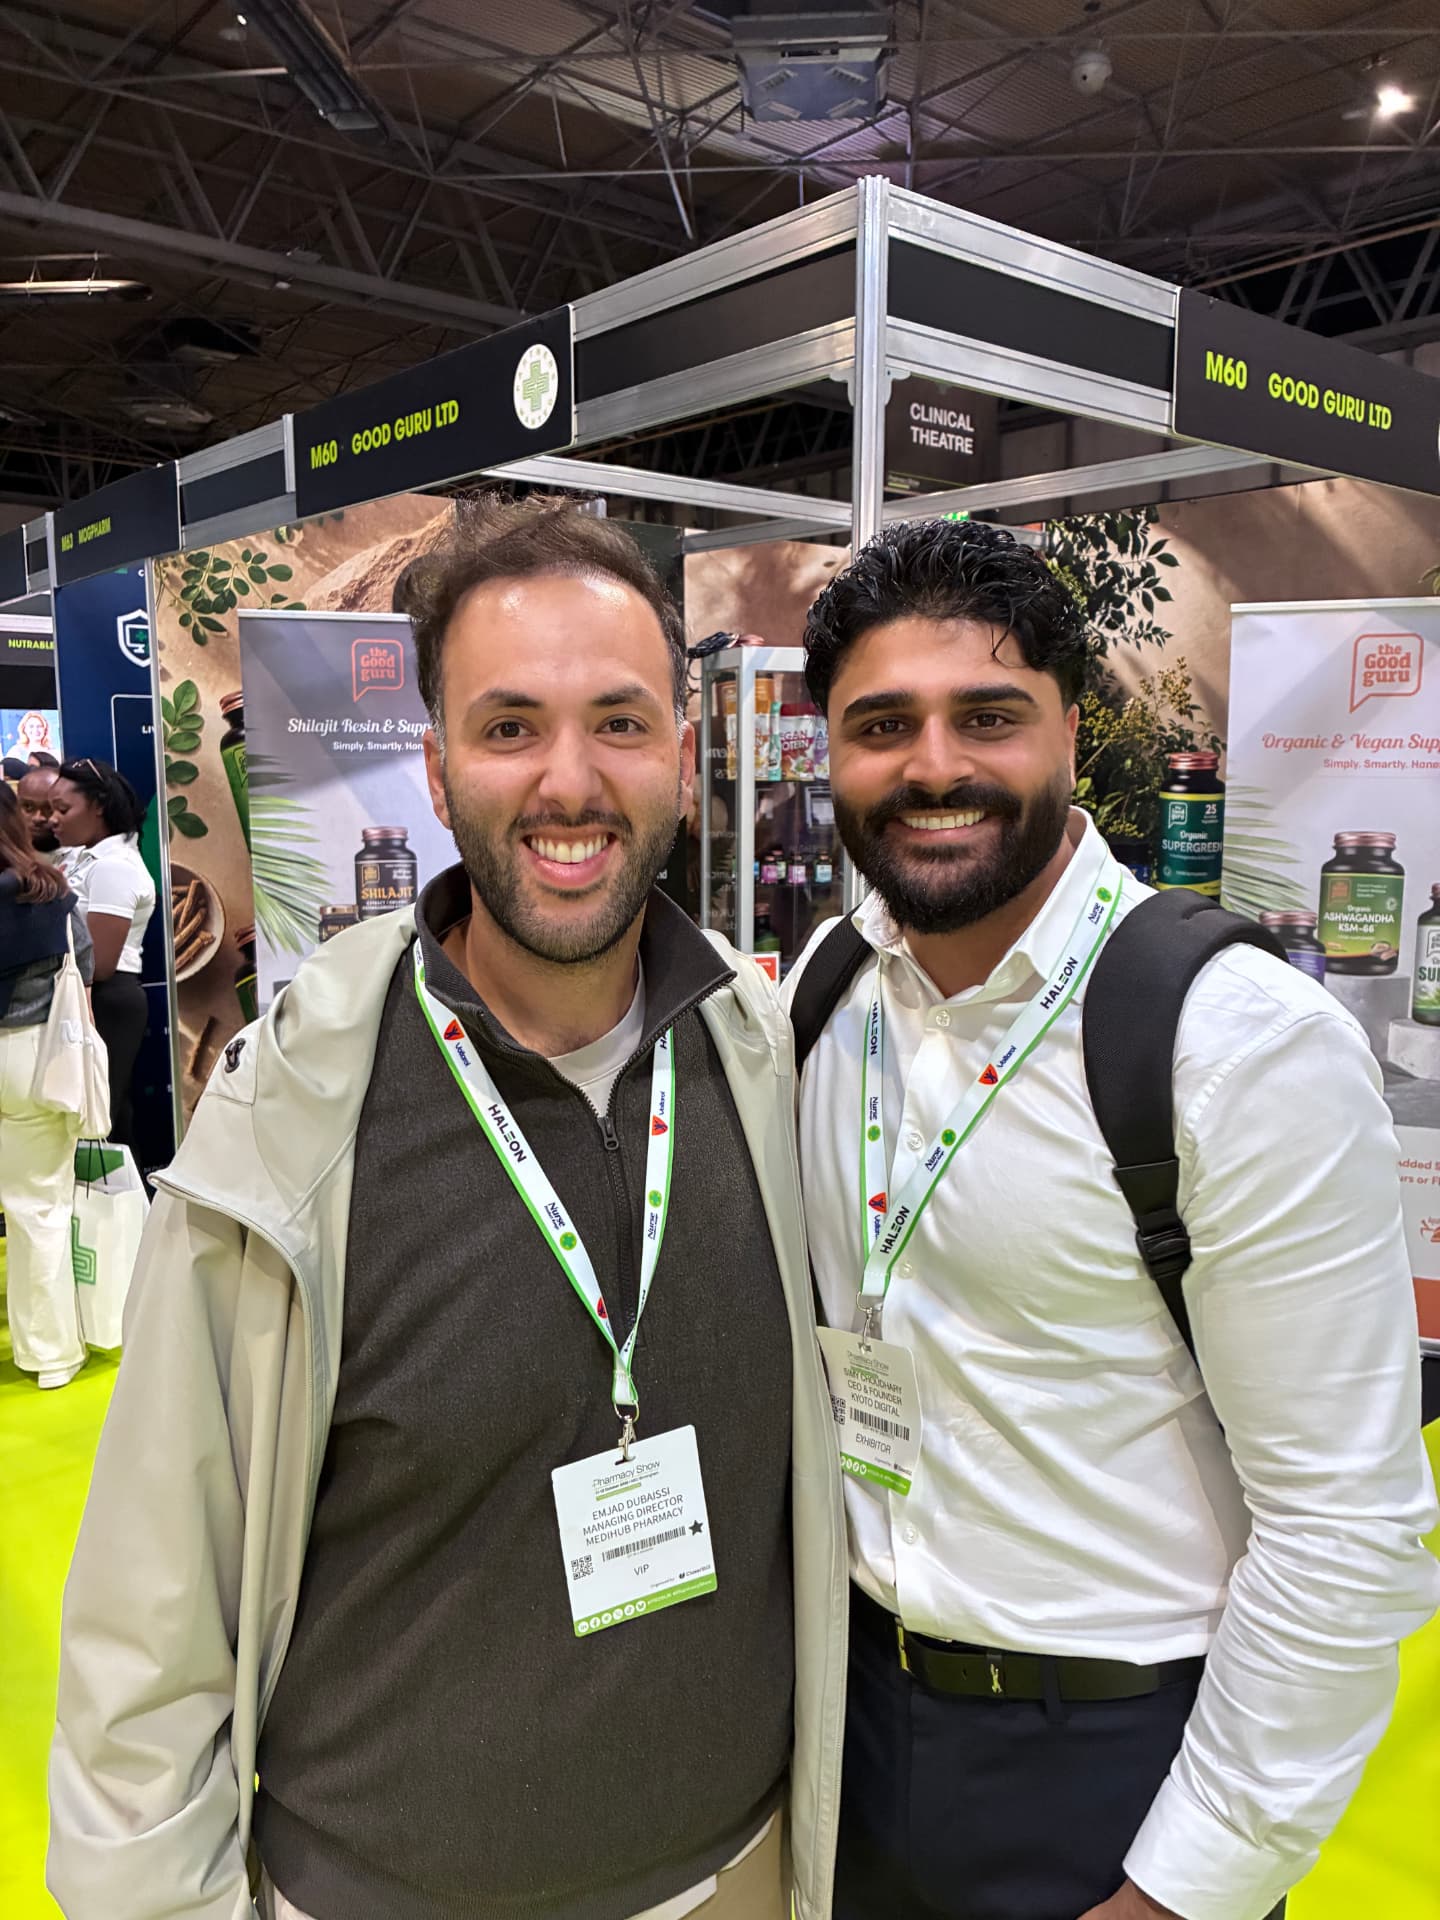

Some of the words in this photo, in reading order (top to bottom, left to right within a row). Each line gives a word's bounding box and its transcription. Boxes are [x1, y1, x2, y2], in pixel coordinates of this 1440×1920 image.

[1205, 351, 1247, 390] M60
[1268, 372, 1320, 410] GOOD
[1323, 389, 1365, 423] GURU
[1368, 402, 1393, 430] LTD
[910, 403, 975, 432] CLINICAL
[310, 439, 338, 469] M60
[351, 423, 391, 455] GOOD
[394, 408, 432, 441] GURU
[435, 400, 460, 428] LTD
[910, 426, 974, 454] THEATRE
[369, 647, 388, 657] the
[1364, 652, 1411, 670] Good
[1378, 643, 1403, 656] the
[360, 655, 395, 668] Good
[360, 668, 396, 682] guru
[1362, 670, 1410, 687] guru
[287, 718, 338, 736] Shilajit
[341, 718, 380, 733] Resin
[383, 719, 395, 733] &
[333, 741, 366, 753] Simply.
[367, 741, 403, 753] Smartly.
[1262, 733, 1329, 753] Organic
[1331, 734, 1345, 749] &
[1350, 734, 1403, 753] Vegan
[1324, 759, 1361, 769] Simply.
[1364, 759, 1408, 769] Smartly.
[1205, 804, 1217, 815] 25
[361, 886, 414, 899] SHILAJIT
[1324, 912, 1394, 923] ASHWAGANDHA
[1040, 957, 1079, 1009] HALEON
[870, 1001, 879, 1056] HALEON
[488, 1104, 527, 1163] HALEON
[925, 1147, 941, 1169] Nurse
[549, 1202, 565, 1227] Nurse
[648, 1212, 656, 1239] Nurse
[880, 1206, 910, 1254] HALEON
[848, 1380, 862, 1391] CEO
[869, 1387, 902, 1406] FOUNDER
[851, 1392, 873, 1407] KYOTO
[875, 1400, 900, 1417] DIGITAL
[855, 1432, 891, 1454] EXHIBITOR
[593, 1469, 635, 1487] Pharmacy
[636, 1461, 660, 1474] Show
[582, 1511, 635, 1536] MANAGING
[636, 1494, 684, 1518] DIRECTOR
[592, 1502, 625, 1520] EMJAD
[626, 1487, 670, 1509] DUBAISSI
[586, 1524, 631, 1546] MEDIHUB
[633, 1506, 684, 1531] PHARMACY
[634, 1563, 650, 1576] VIP
